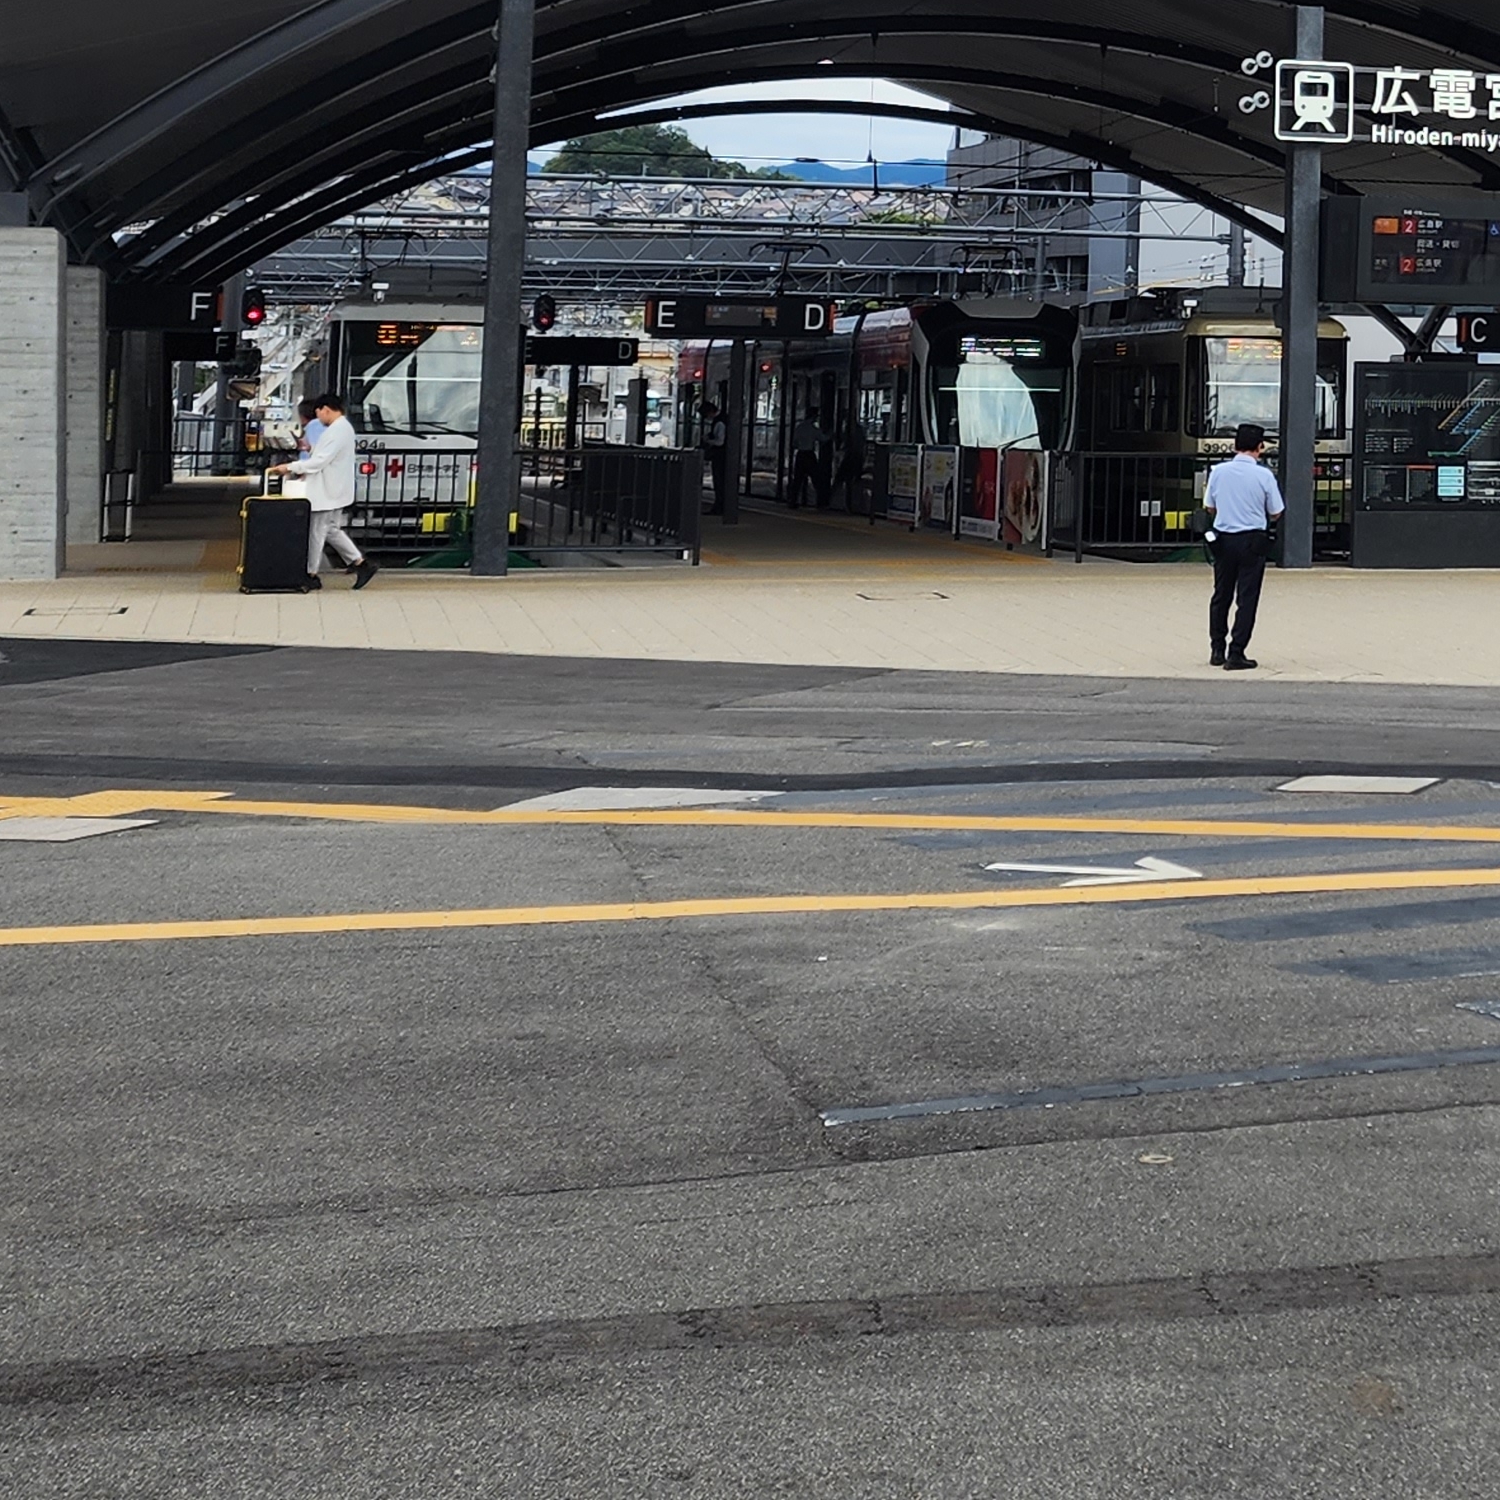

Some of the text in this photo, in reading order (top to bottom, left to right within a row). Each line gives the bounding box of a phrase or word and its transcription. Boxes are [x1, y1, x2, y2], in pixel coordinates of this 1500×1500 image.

[1405, 220, 1413, 233] 2
[1403, 259, 1411, 272] 2
[190, 292, 212, 320] F
[657, 301, 676, 328] E
[804, 304, 825, 330] D
[1470, 317, 1487, 343] C
[215, 335, 229, 354] F
[618, 341, 632, 359] D
